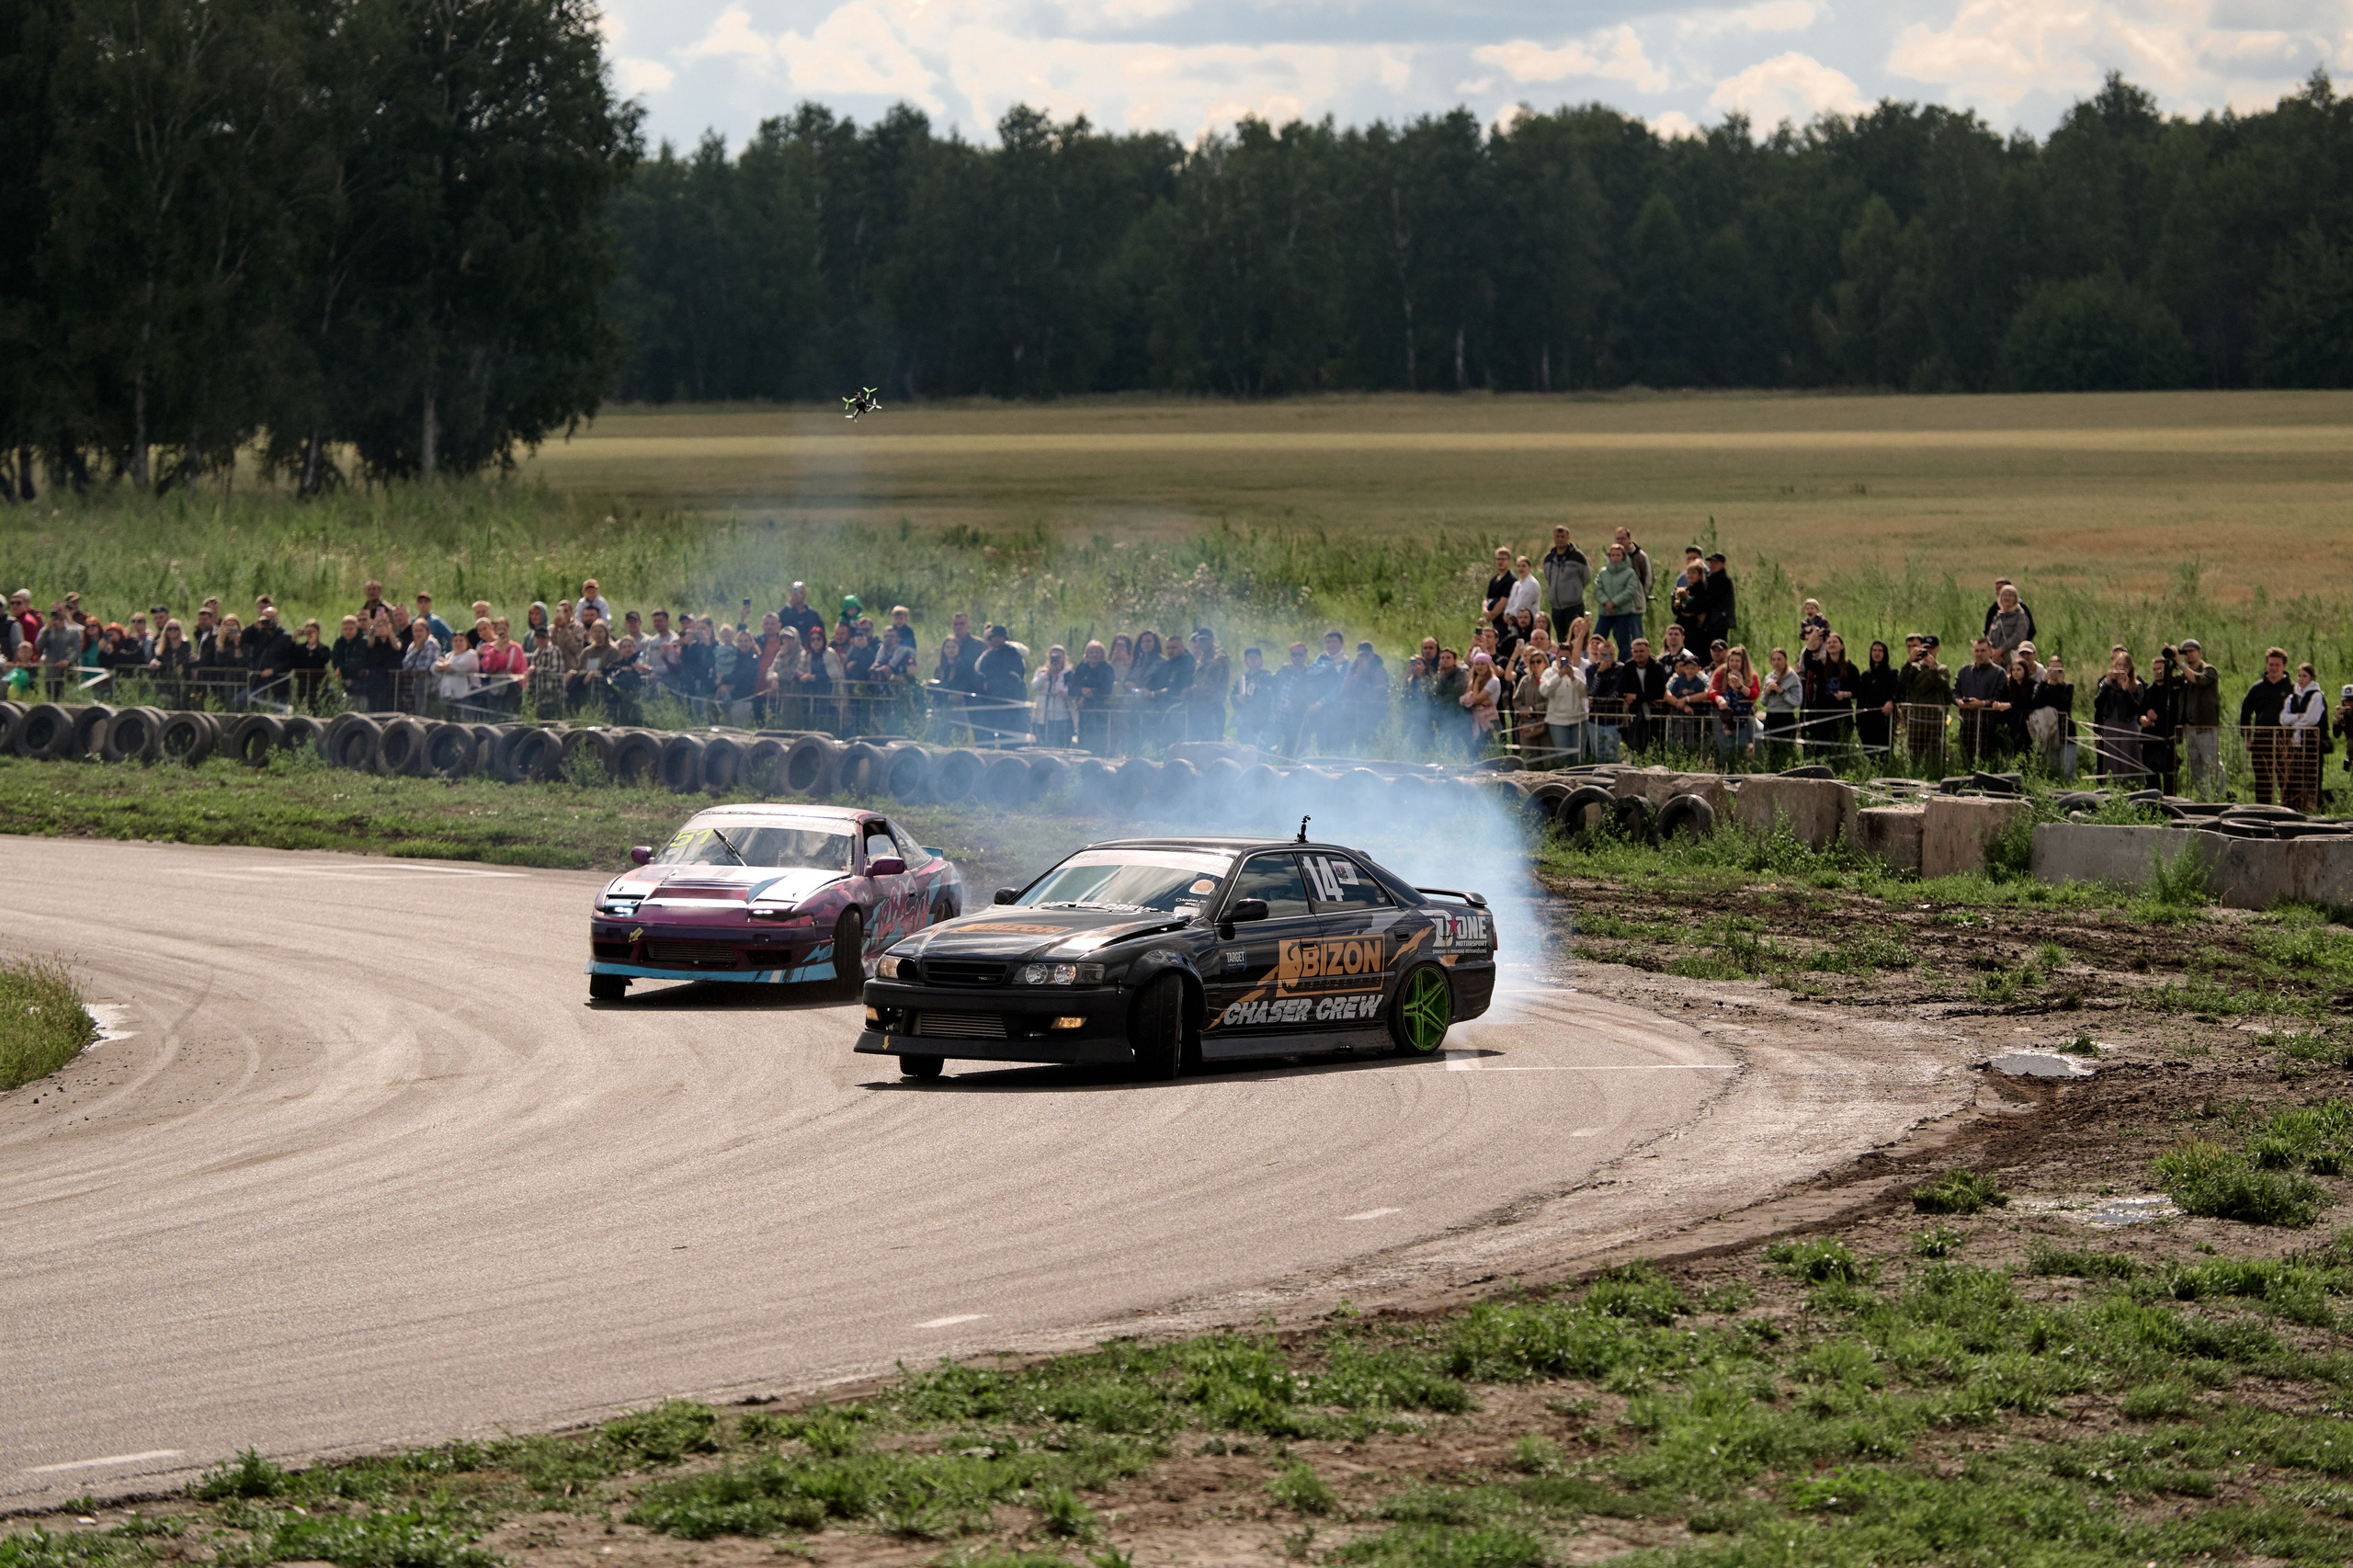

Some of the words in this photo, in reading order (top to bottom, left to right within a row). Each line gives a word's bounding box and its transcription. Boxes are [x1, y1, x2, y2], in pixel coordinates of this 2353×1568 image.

[669, 828, 714, 847] 51
[1302, 856, 1345, 902] 14
[1225, 950, 1245, 963] TARGET
[1301, 939, 1381, 978] BIZON
[1223, 998, 1313, 1026] CHASER
[1315, 994, 1384, 1021] CREW
